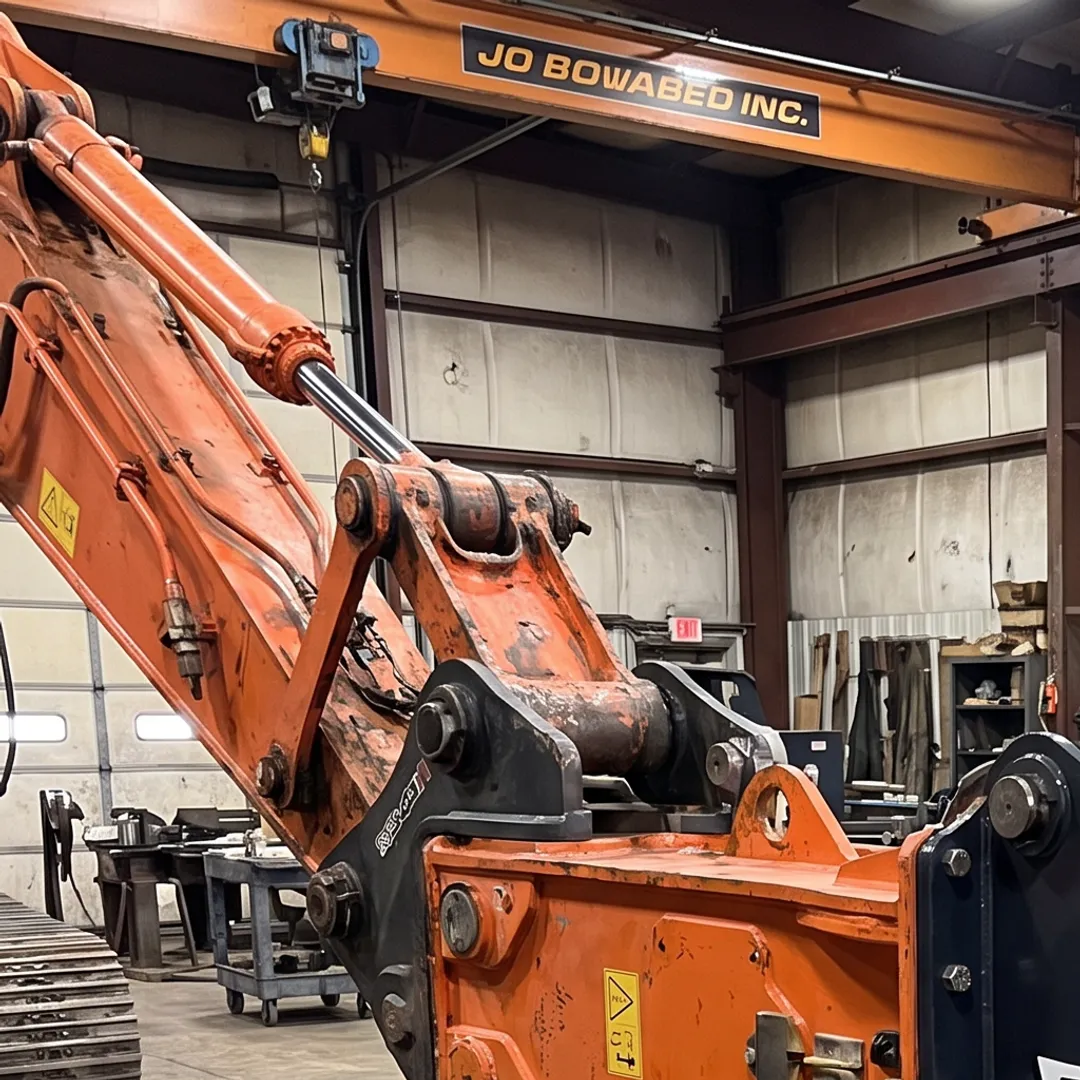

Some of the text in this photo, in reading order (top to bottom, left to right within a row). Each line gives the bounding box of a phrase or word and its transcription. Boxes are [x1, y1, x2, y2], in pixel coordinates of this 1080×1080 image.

[477, 43, 808, 127] JO BOWABED INC.
